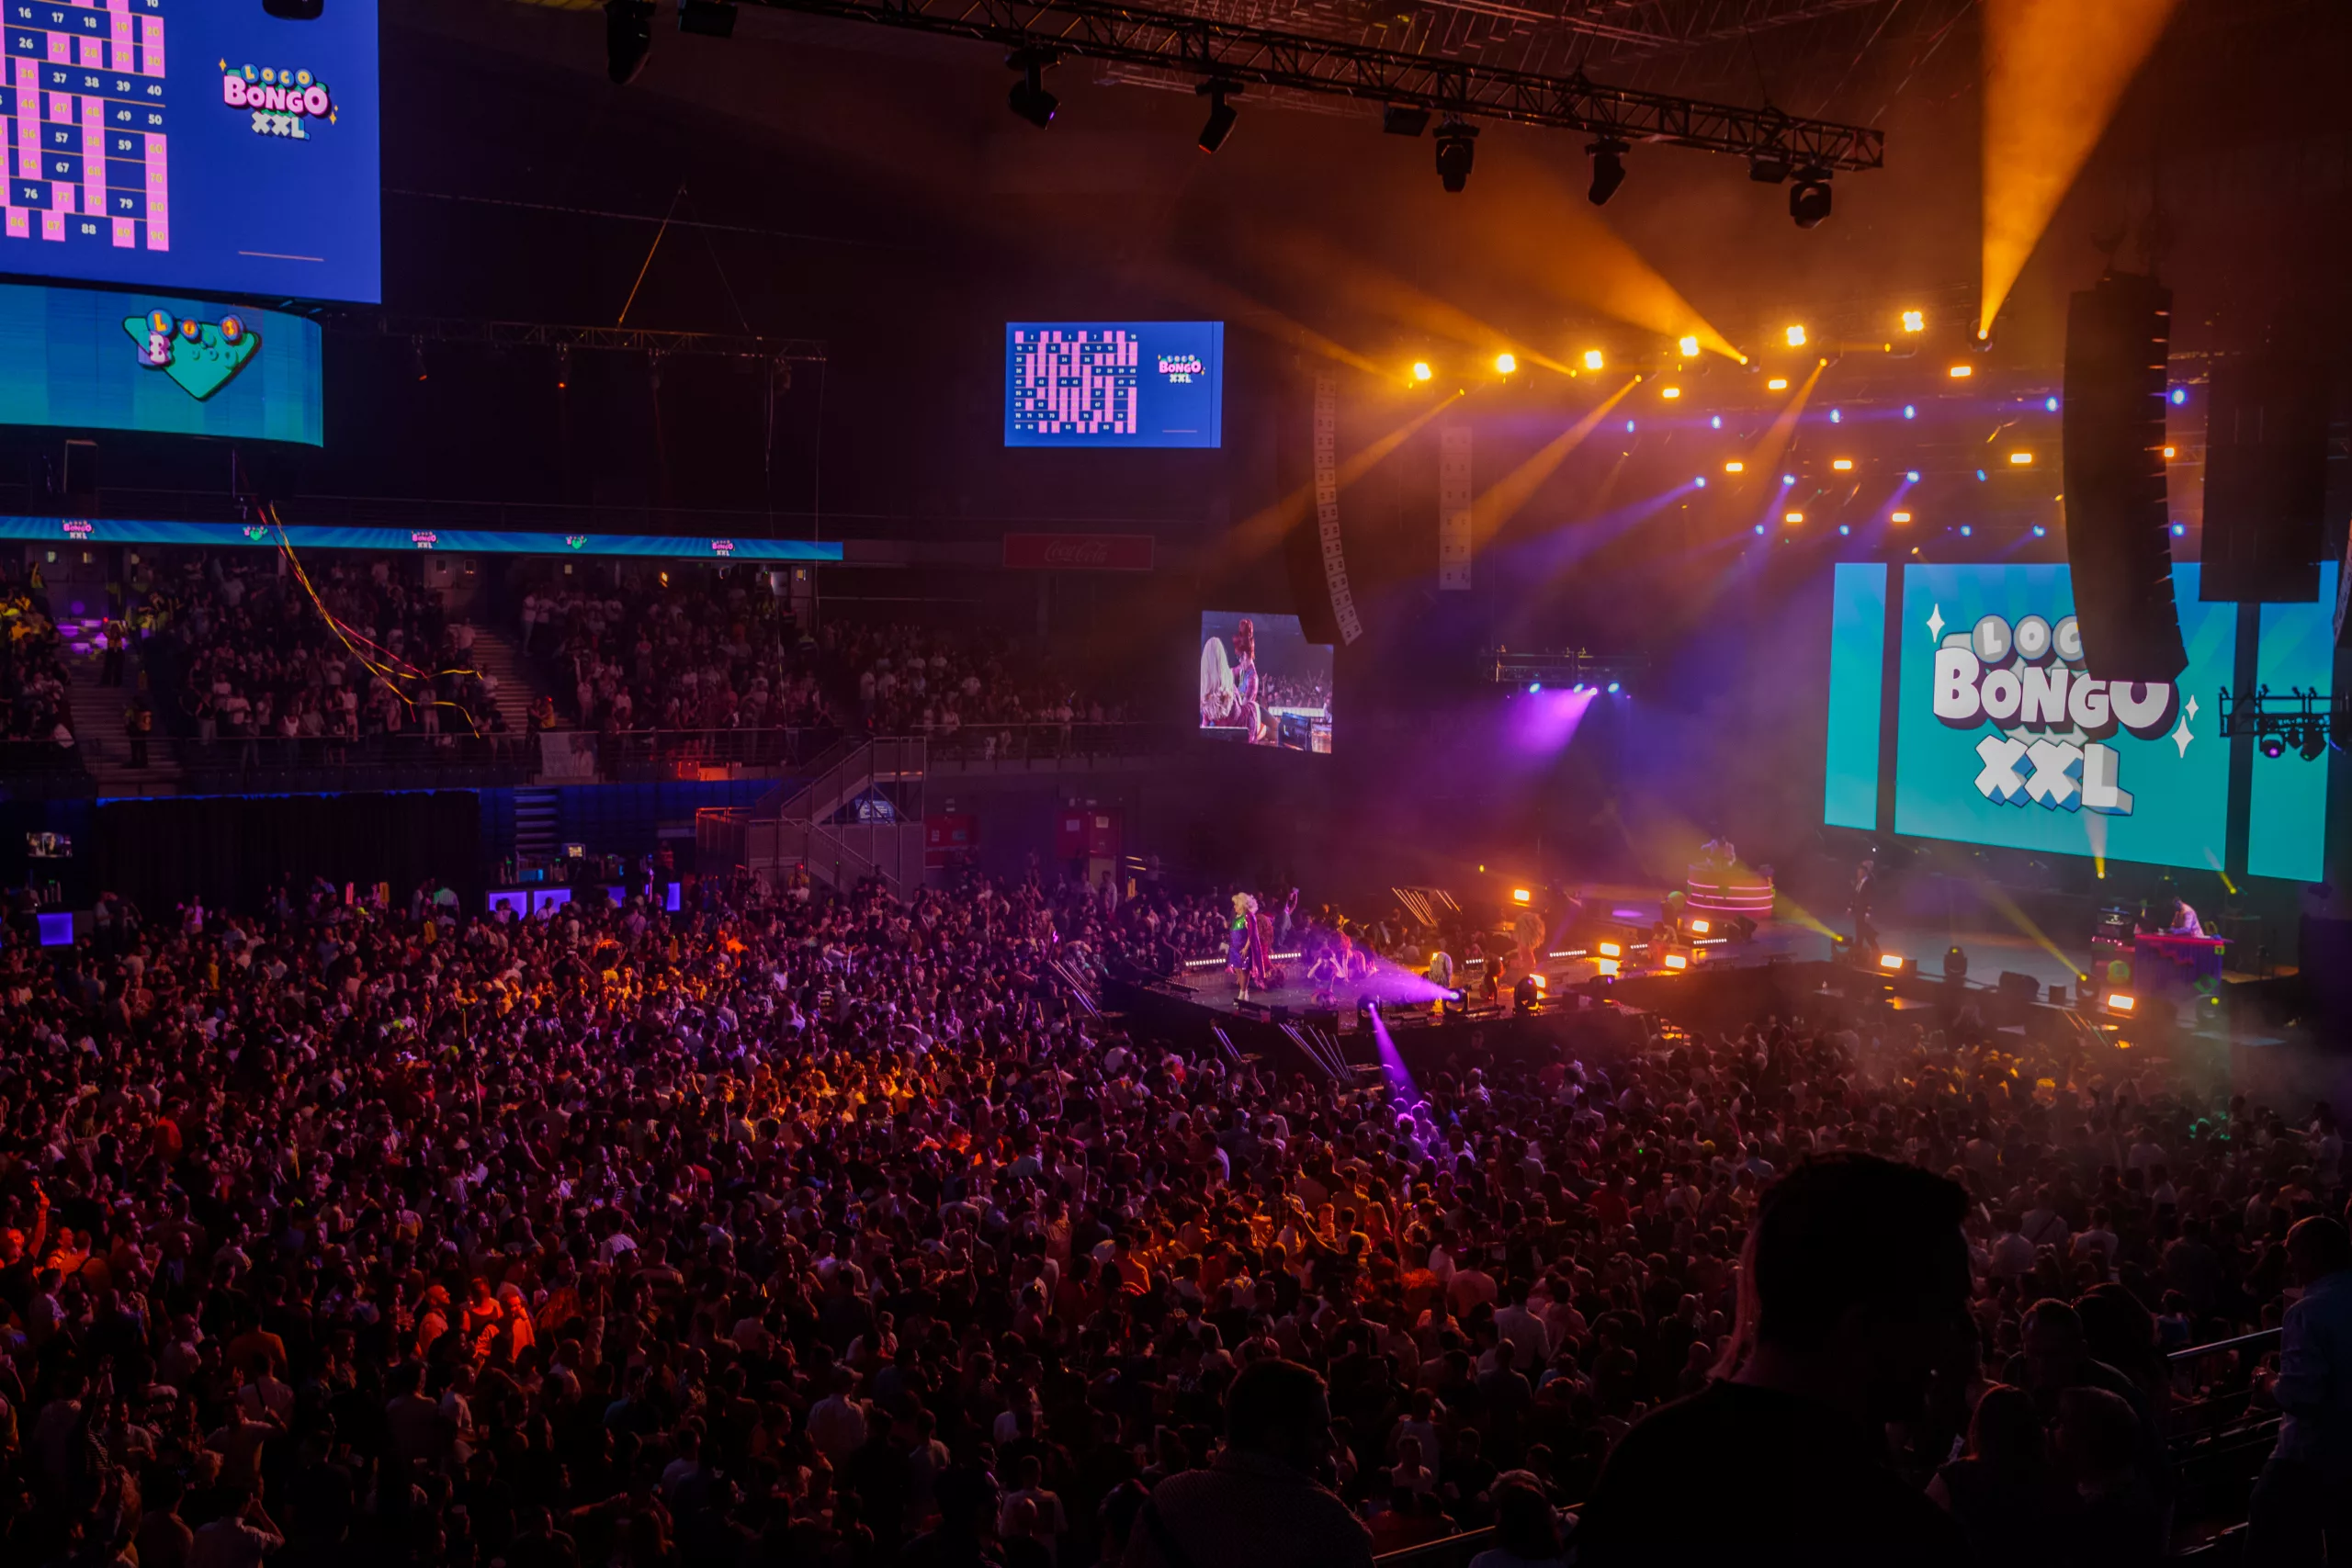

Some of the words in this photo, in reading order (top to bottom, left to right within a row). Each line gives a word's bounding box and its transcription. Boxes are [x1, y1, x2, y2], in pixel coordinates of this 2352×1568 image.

[18, 7, 32, 18] 16
[51, 12, 64, 23] 17
[83, 17, 97, 28] 18
[116, 22, 129, 32] 19
[146, 26, 160, 37] 20
[18, 37, 34, 49] 26
[52, 42, 66, 52] 27
[85, 47, 98, 58] 28
[116, 51, 130, 62] 29
[147, 56, 161, 66] 30
[20, 68, 35, 80] 36
[52, 72, 67, 84] 37
[85, 76, 100, 88] 38
[116, 80, 131, 92] 39
[146, 85, 163, 96] 40
[243, 64, 311, 86] LOCO
[224, 74, 328, 115] BONGO
[21, 98, 36, 109] 46
[54, 103, 68, 112] 47
[85, 107, 100, 117] 48
[117, 110, 132, 121] 49
[148, 114, 163, 125] 50
[251, 111, 308, 139] XXL
[22, 128, 37, 140] 56
[55, 132, 69, 143] 57
[118, 140, 132, 151] 59
[55, 162, 70, 173] 67
[150, 174, 164, 183] 70
[23, 187, 39, 199] 76
[57, 192, 71, 201] 77
[88, 195, 103, 206] 78
[119, 197, 133, 209] 79
[47, 220, 61, 231] 87
[81, 223, 96, 235] 88
[151, 231, 165, 241] 90
[1159, 360, 1202, 374] BONGO
[1170, 373, 1192, 384] XXL
[1979, 617, 2082, 659] LOC
[1974, 735, 2127, 811] XXL
